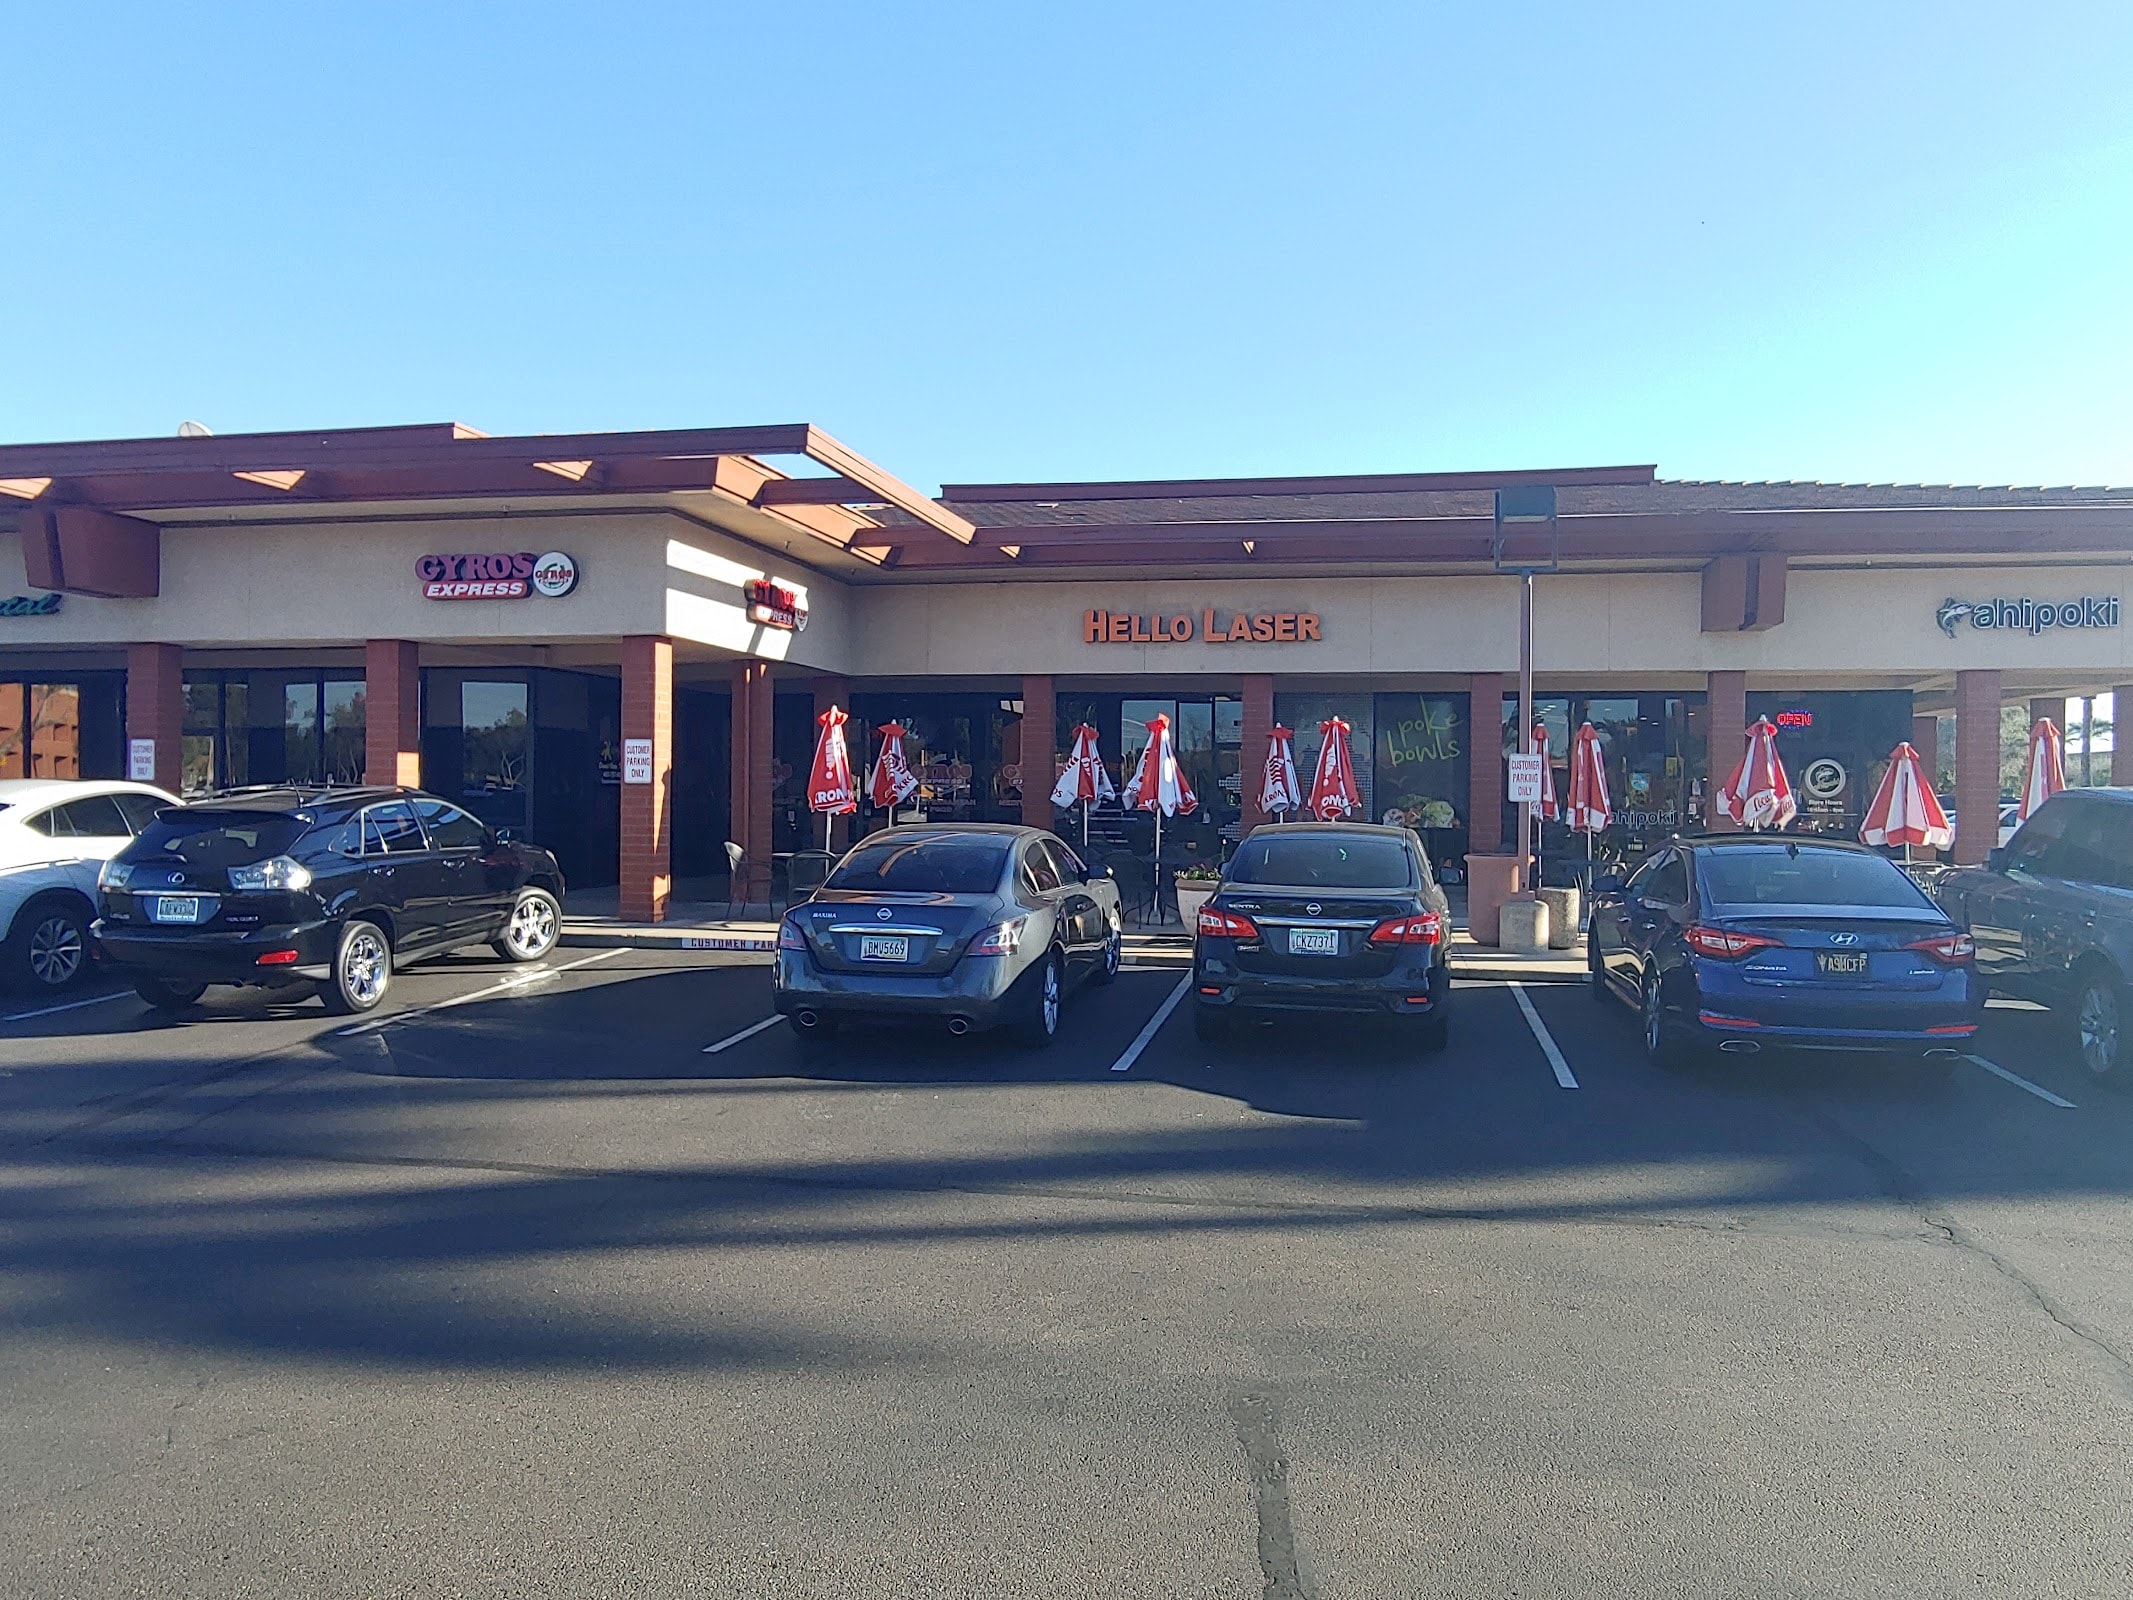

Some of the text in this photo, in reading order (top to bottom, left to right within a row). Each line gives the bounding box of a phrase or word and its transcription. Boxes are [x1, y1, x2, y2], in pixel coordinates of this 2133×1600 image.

[415, 552, 537, 581] GYROS
[427, 583, 523, 597] EXPRESS
[0, 593, 62, 616] tal
[1973, 597, 2120, 636] ahipoki
[1084, 608, 1322, 643] HELLO LASER
[1398, 693, 1464, 748] poke
[1777, 713, 1812, 727] OPEN
[626, 745, 650, 754] CUSTOMER
[626, 757, 650, 766] PARKING
[1511, 760, 1540, 770] CUSTOMER
[631, 768, 645, 777] ONLY
[1512, 773, 1539, 783] PARKING
[1517, 786, 1533, 796] ONLY
[691, 938, 776, 950] CUSTOMER PAR
[1295, 934, 1335, 949] CKZ7371
